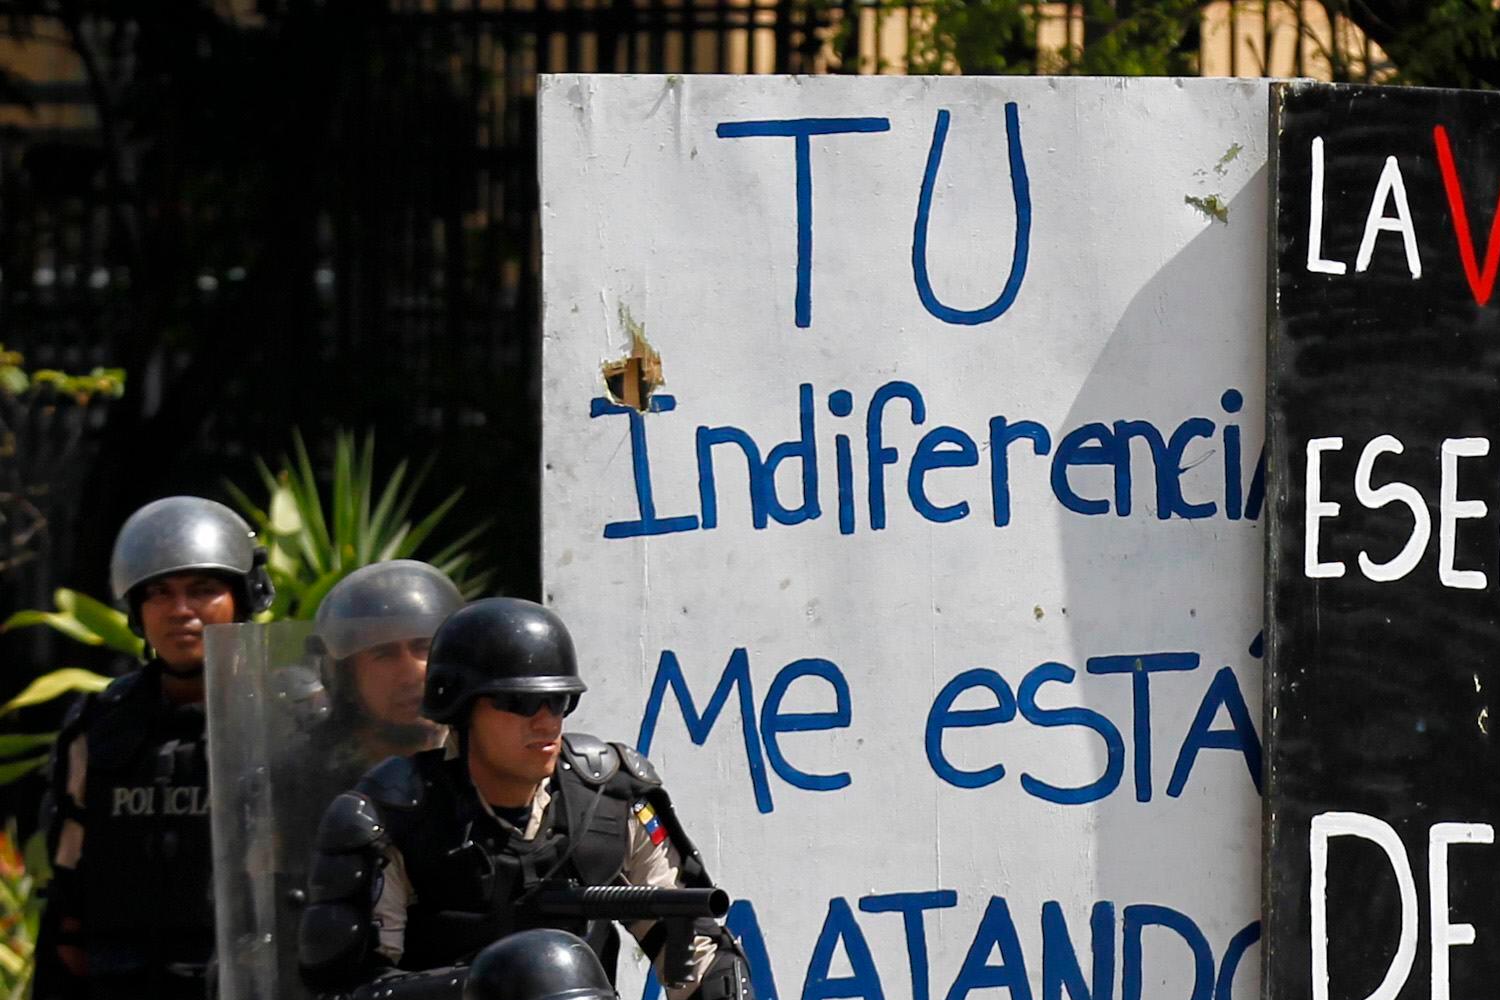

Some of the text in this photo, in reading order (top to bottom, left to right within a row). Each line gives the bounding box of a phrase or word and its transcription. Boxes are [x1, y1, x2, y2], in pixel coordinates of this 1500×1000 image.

[716, 101, 1031, 328] TU
[1306, 136, 1422, 280] LA
[590, 381, 1265, 539] Indiferenci
[636, 647, 852, 814] Me
